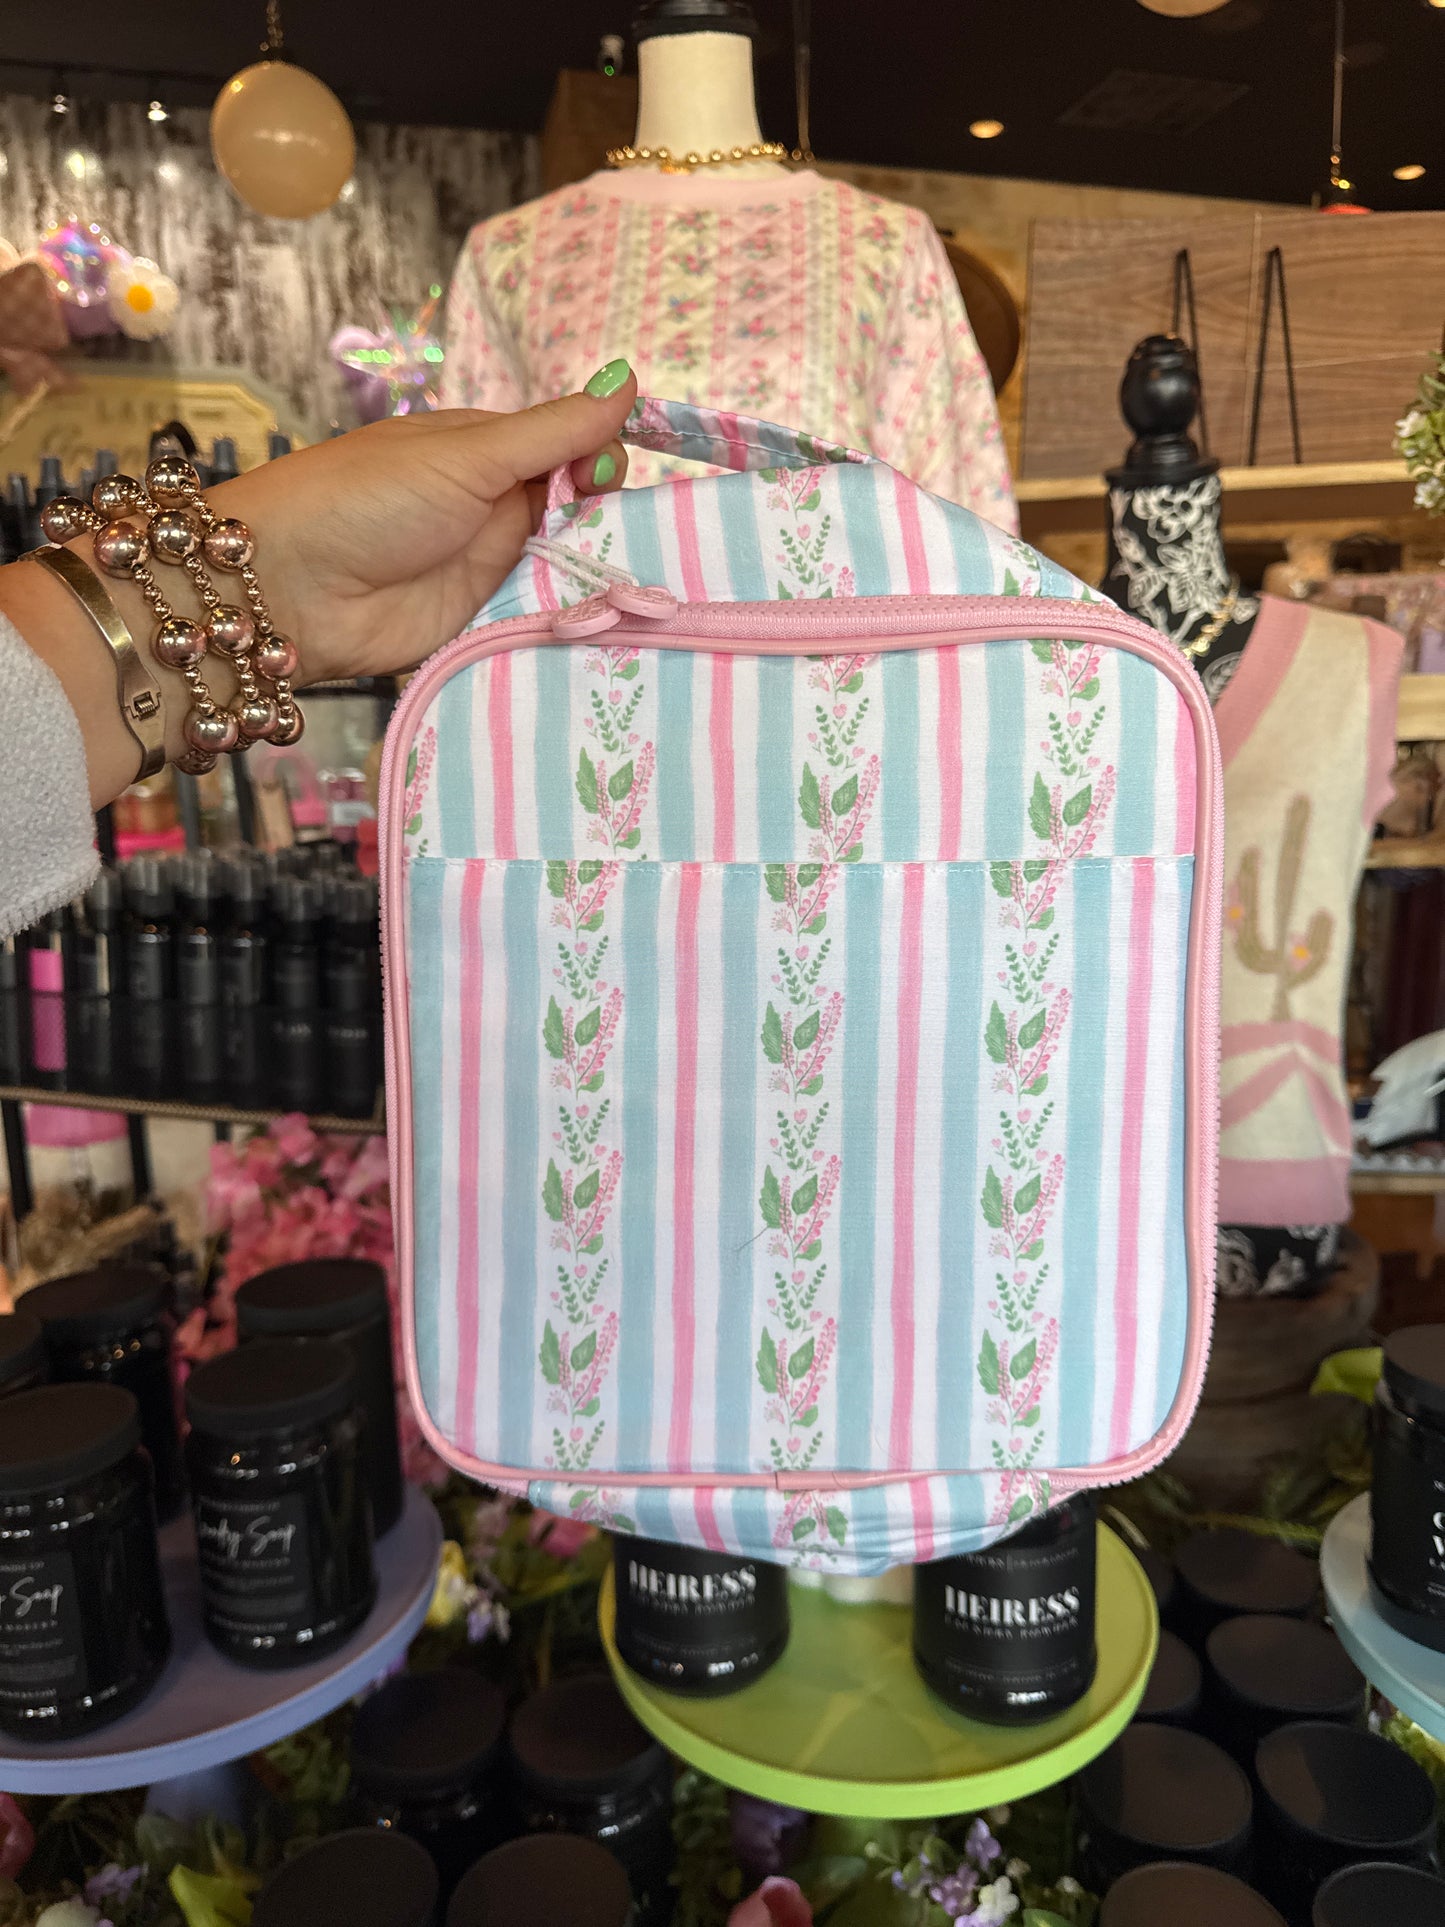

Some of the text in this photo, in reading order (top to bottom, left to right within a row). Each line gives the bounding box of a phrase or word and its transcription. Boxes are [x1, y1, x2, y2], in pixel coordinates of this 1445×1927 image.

[246, 1515, 296, 1556] Soap
[10, 1576, 63, 1617] Soap
[628, 1559, 757, 1602] HEIRESS
[944, 1584, 1081, 1627] HEIRESS
